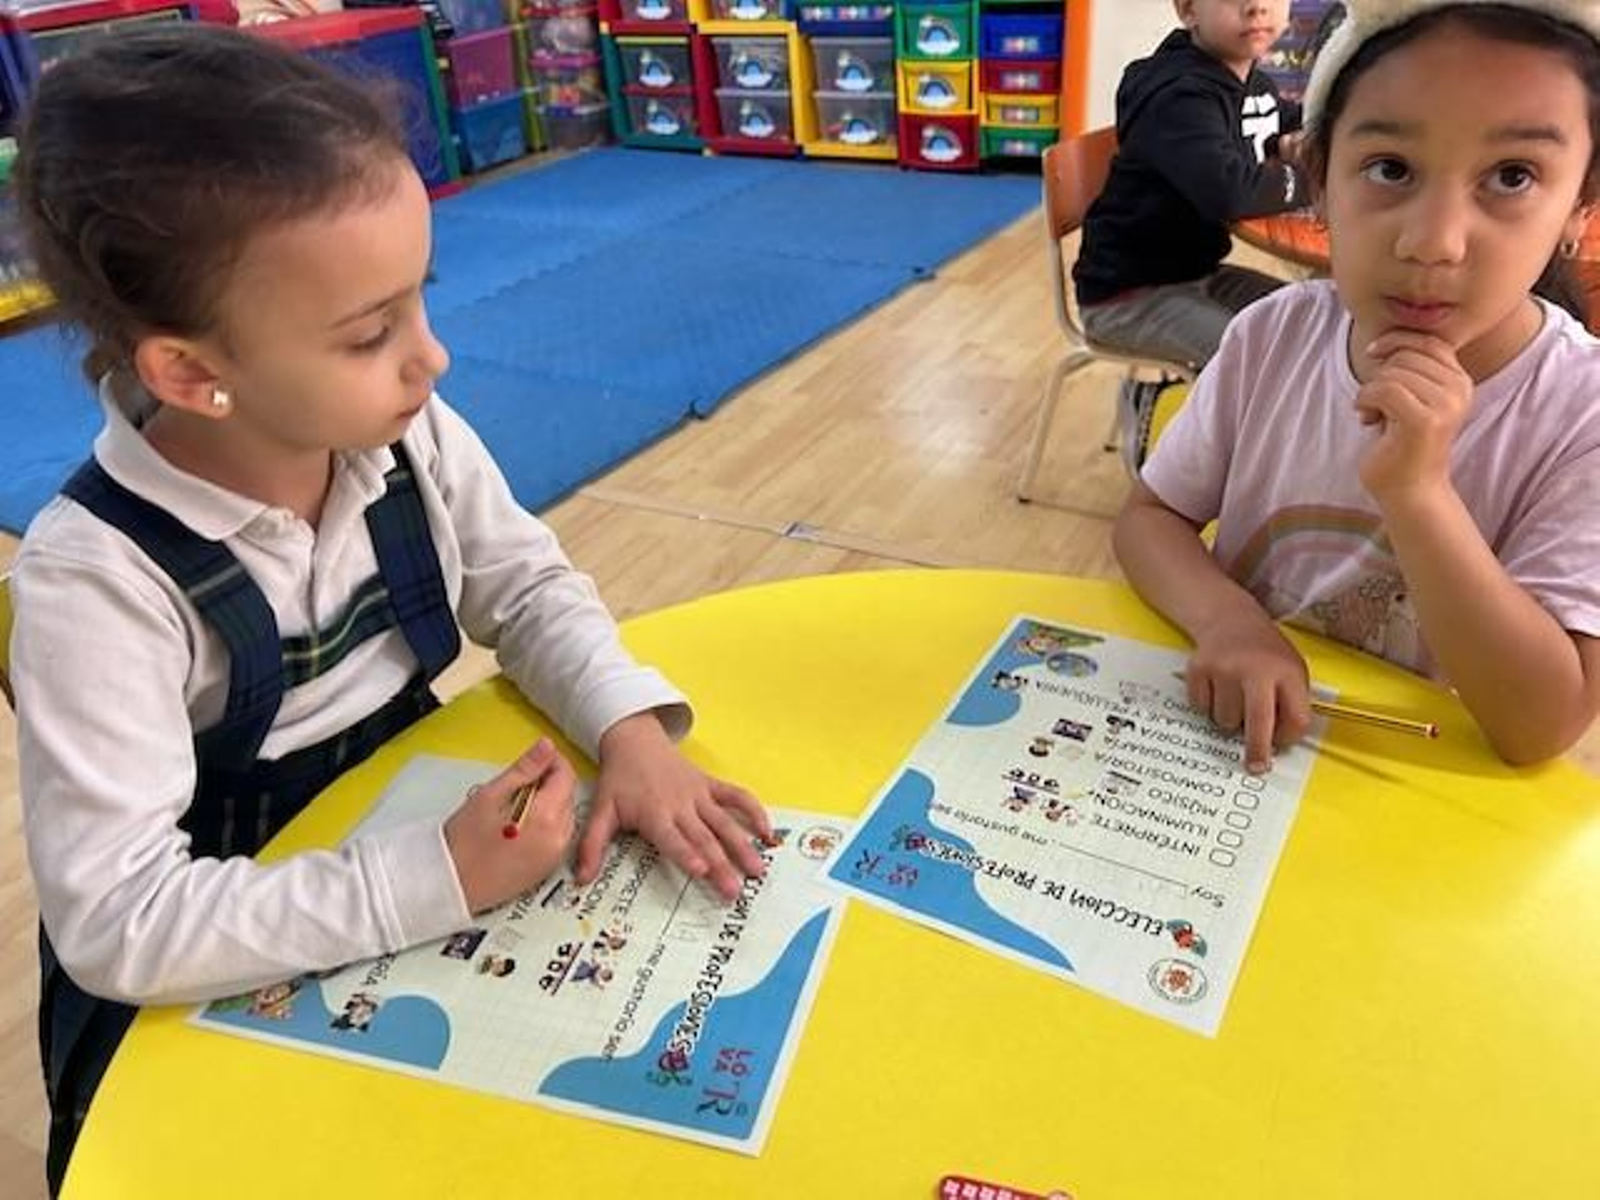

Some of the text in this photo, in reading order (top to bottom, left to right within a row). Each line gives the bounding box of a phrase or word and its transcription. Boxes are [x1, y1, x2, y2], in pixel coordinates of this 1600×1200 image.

[1040, 879, 1066, 901] DE
[1190, 885, 1225, 908] Soy
[718, 922, 745, 942] DE
